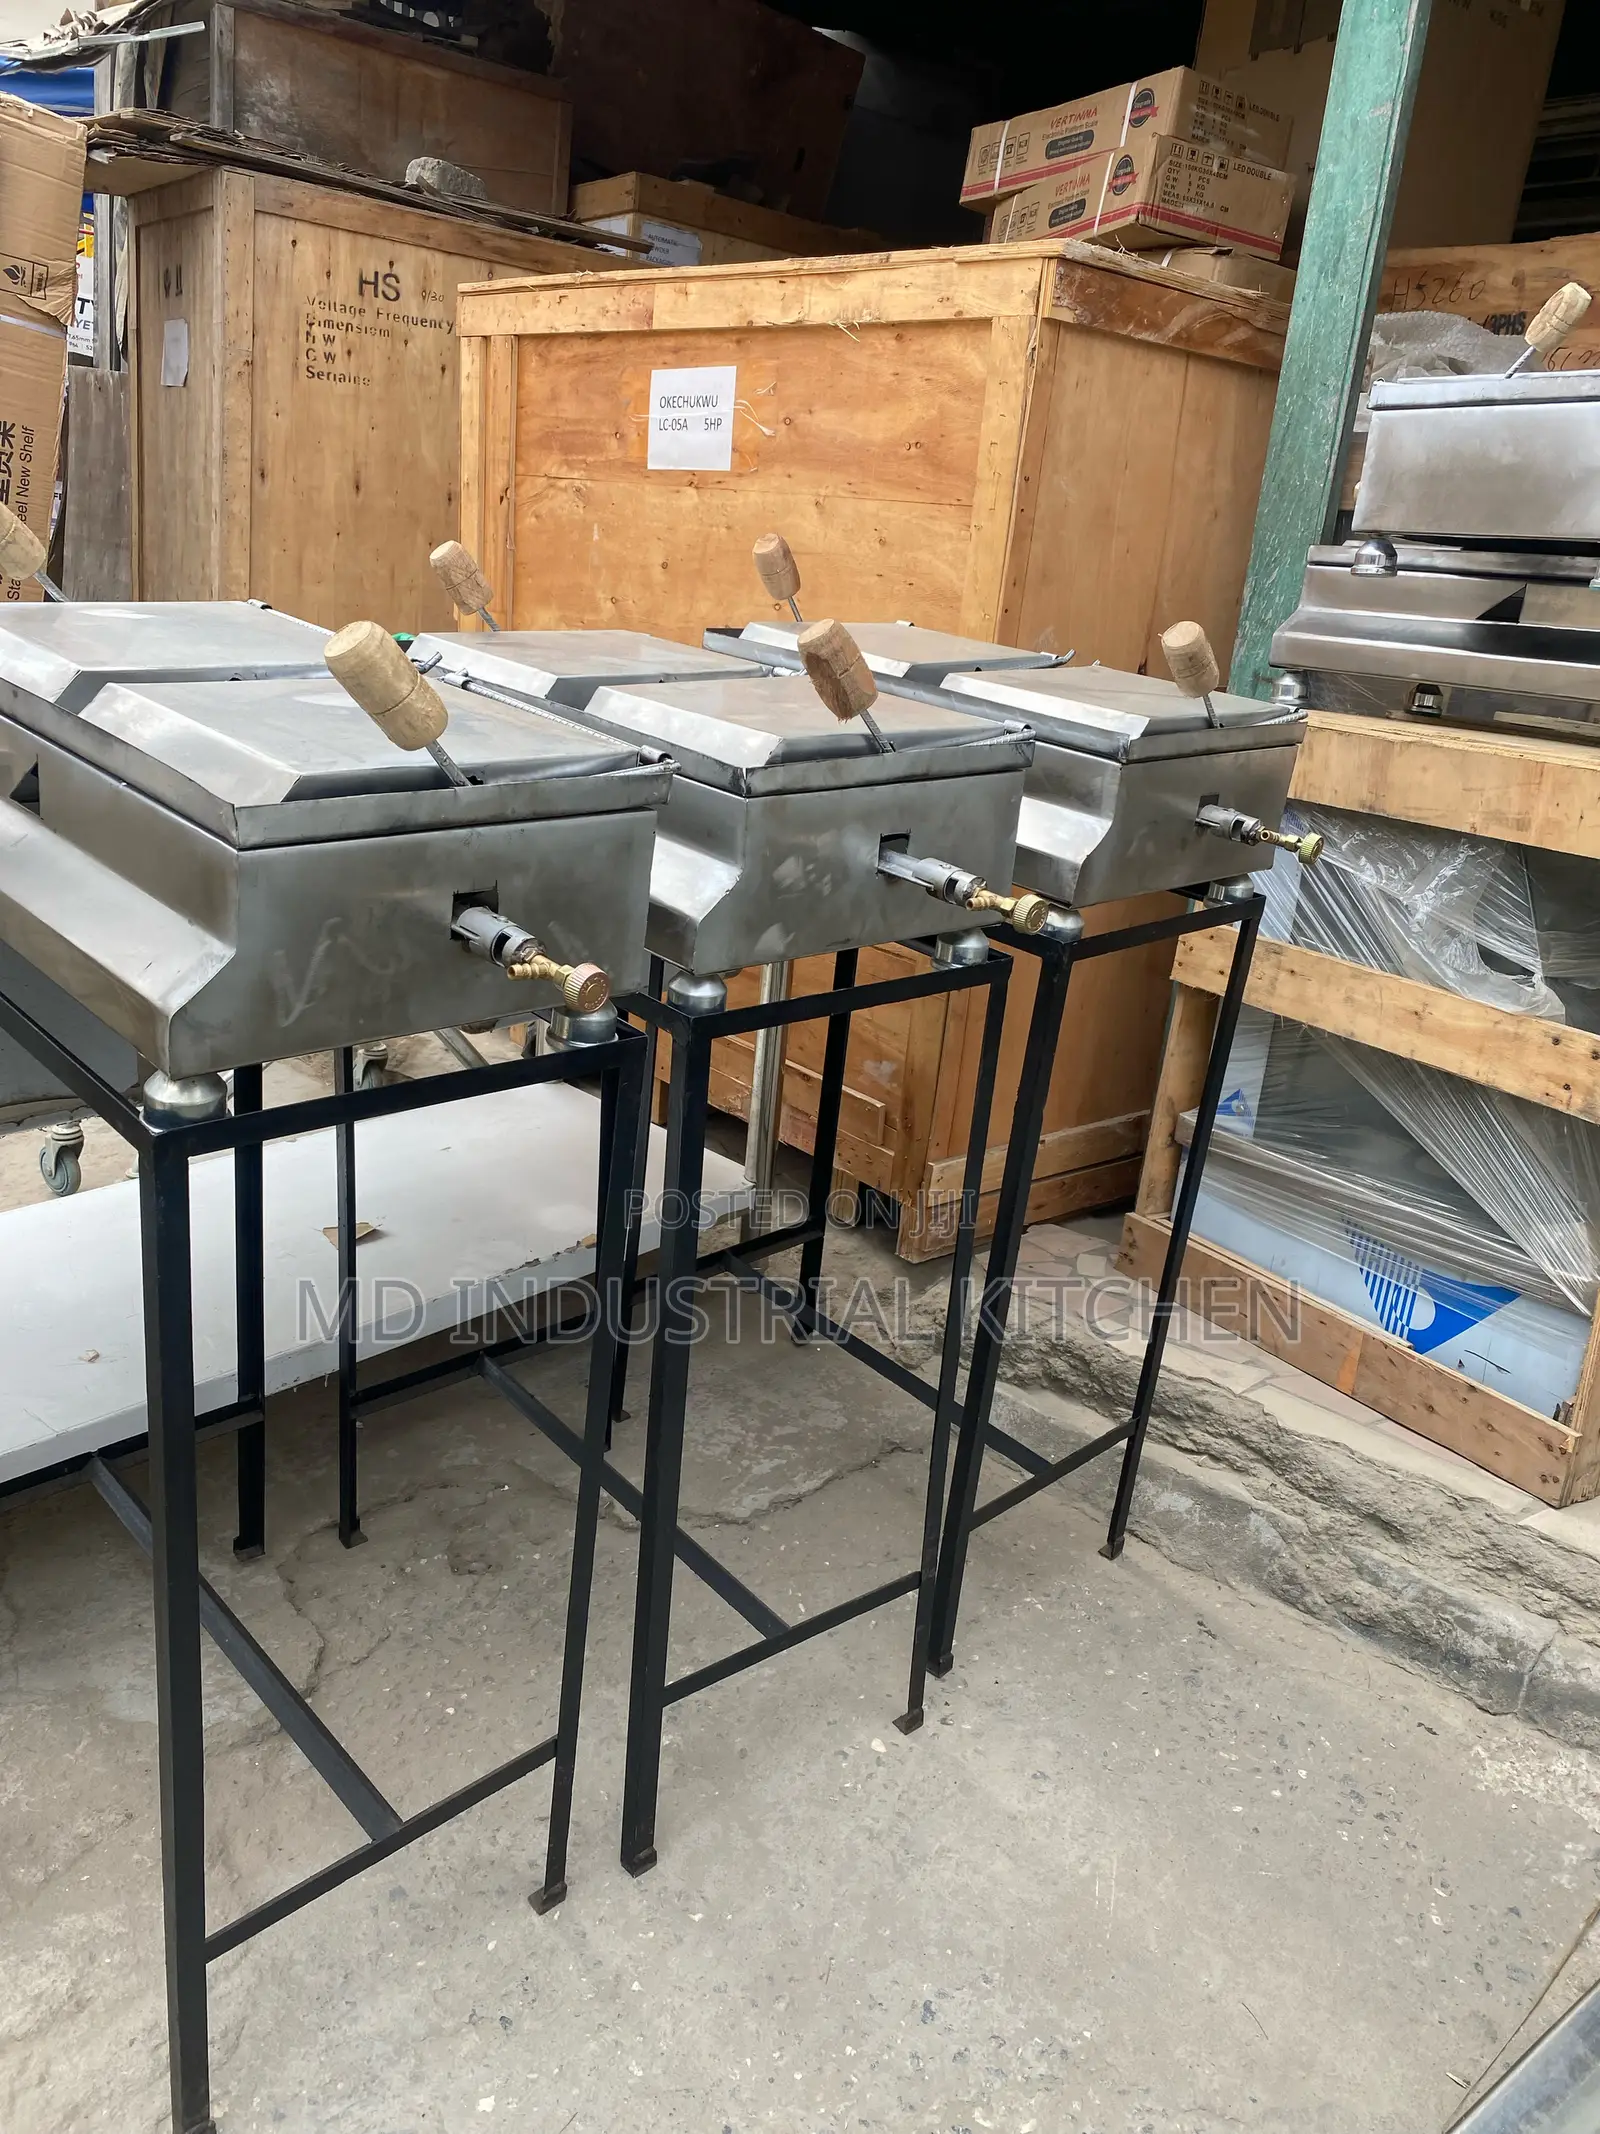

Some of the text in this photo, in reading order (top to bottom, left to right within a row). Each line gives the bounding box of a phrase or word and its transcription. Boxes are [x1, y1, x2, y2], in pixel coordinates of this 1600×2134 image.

[1051, 106, 1097, 129] VERTINMA
[1233, 163, 1272, 181] LED DOUBLE
[376, 307, 455, 335] Frequency
[660, 395, 719, 408] OKECHUKWU
[658, 418, 723, 431] LC-05A 5HP
[19, 425, 35, 463] Shelf
[16, 466, 31, 498] New
